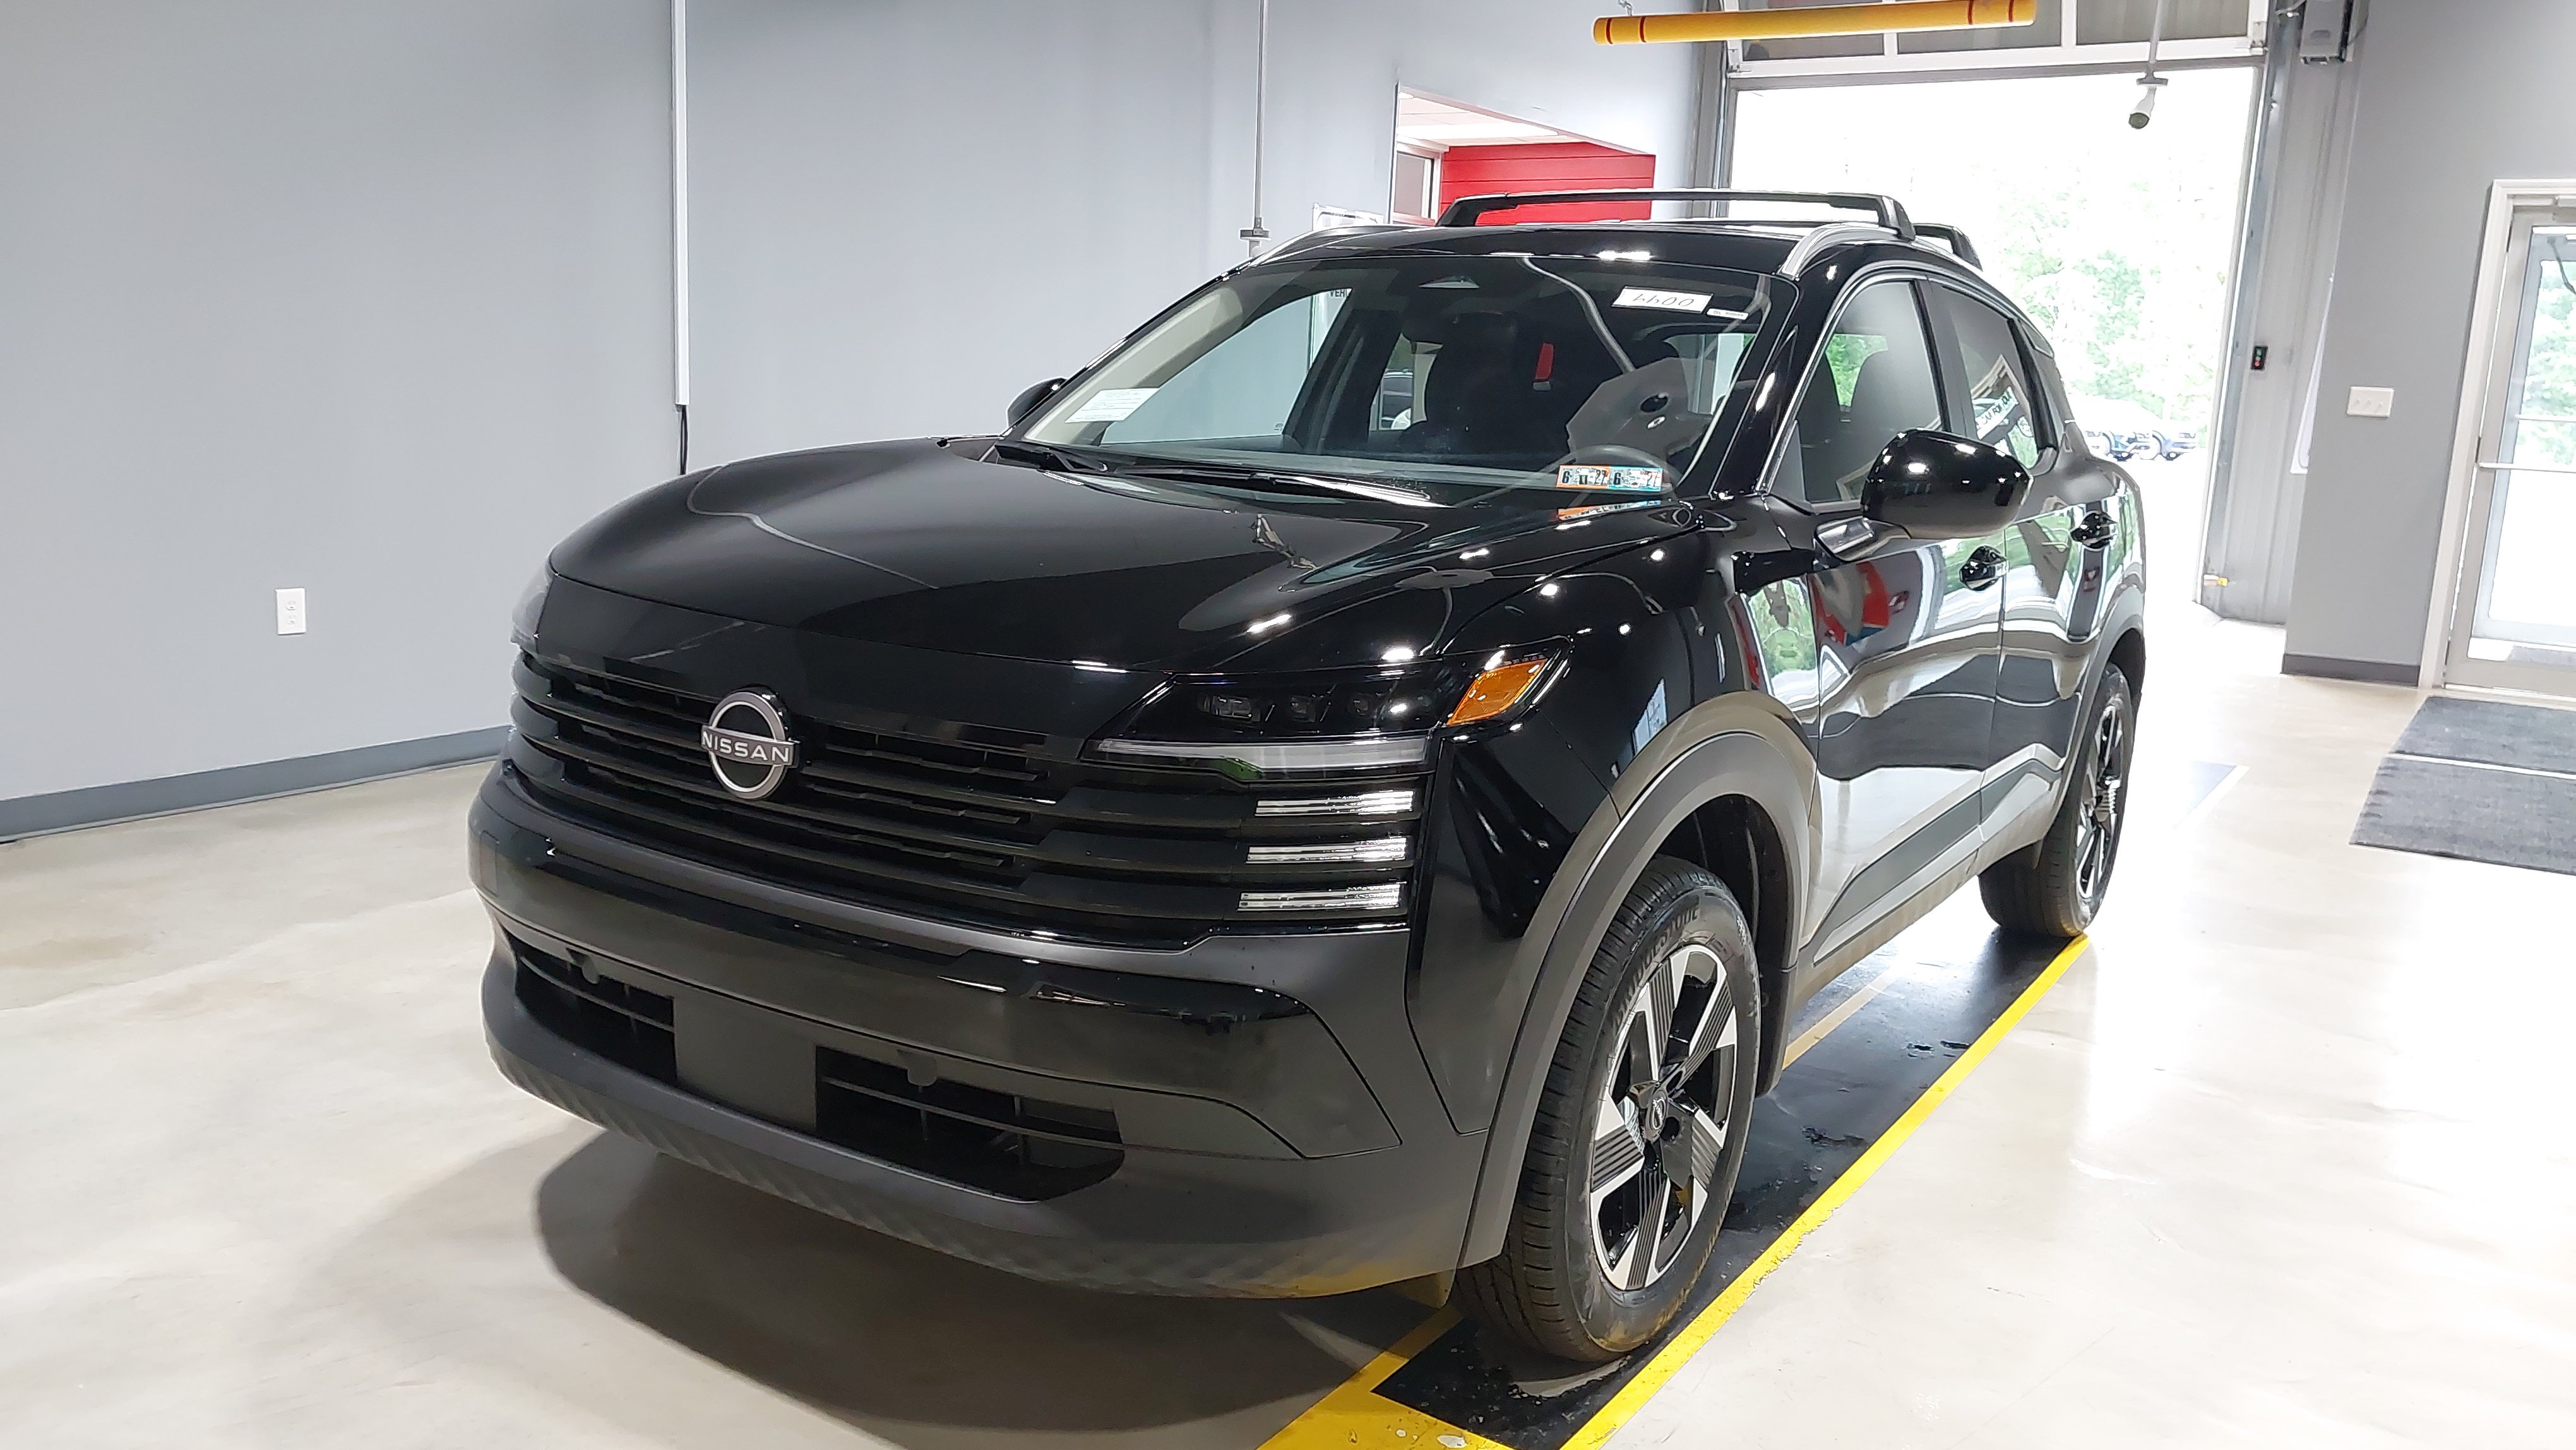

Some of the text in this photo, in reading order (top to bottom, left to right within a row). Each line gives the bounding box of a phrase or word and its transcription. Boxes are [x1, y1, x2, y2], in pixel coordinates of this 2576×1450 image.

[1330, 289, 1347, 297] VEHI
[1561, 470, 1571, 484] 6
[1613, 472, 1621, 486] 6
[702, 731, 789, 762] NISSAN
